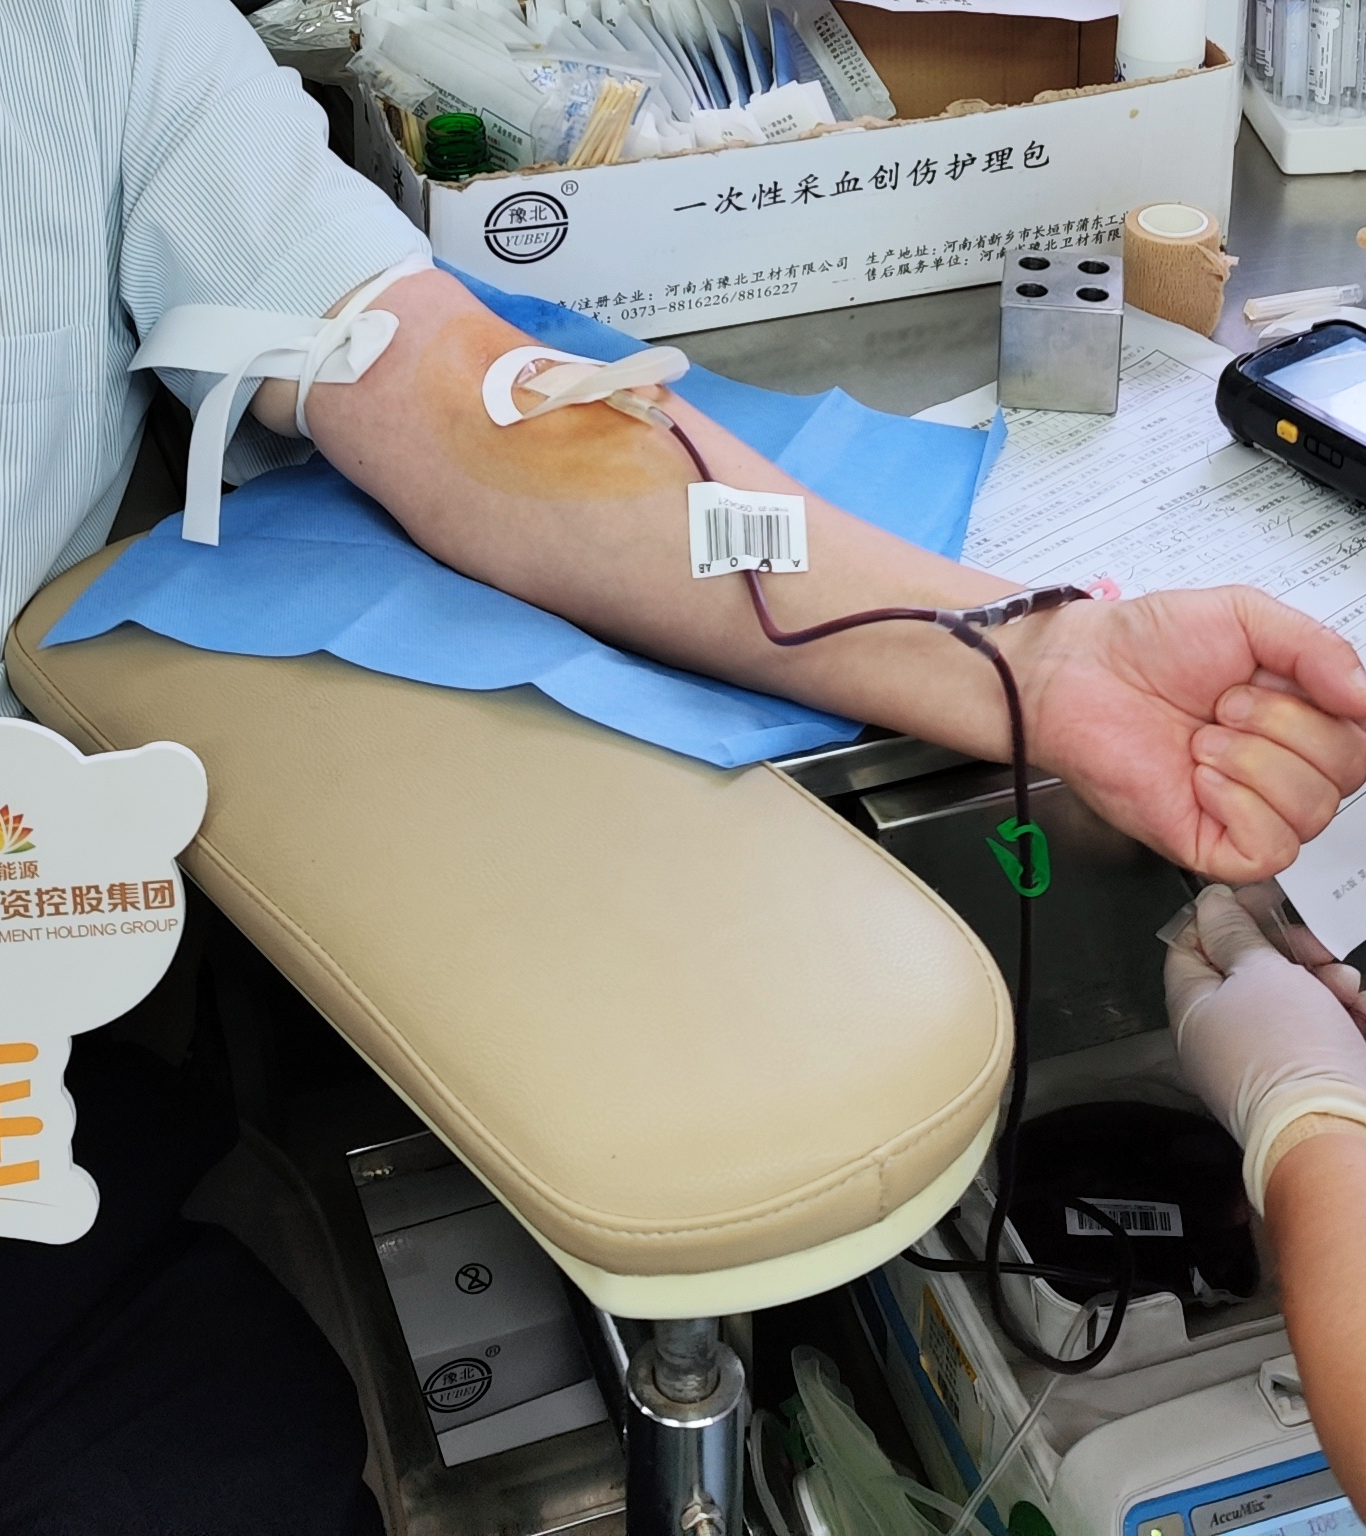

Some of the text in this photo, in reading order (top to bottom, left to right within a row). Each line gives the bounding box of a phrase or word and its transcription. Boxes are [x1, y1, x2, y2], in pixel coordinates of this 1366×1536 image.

[673, 138, 1052, 214] 一次性采血创伤护理包
[508, 205, 549, 224] 豫北
[505, 231, 551, 248] YUBEI
[46, 923, 117, 940] HOLDING
[120, 918, 179, 935] GROUP
[441, 1367, 475, 1385] 豫北
